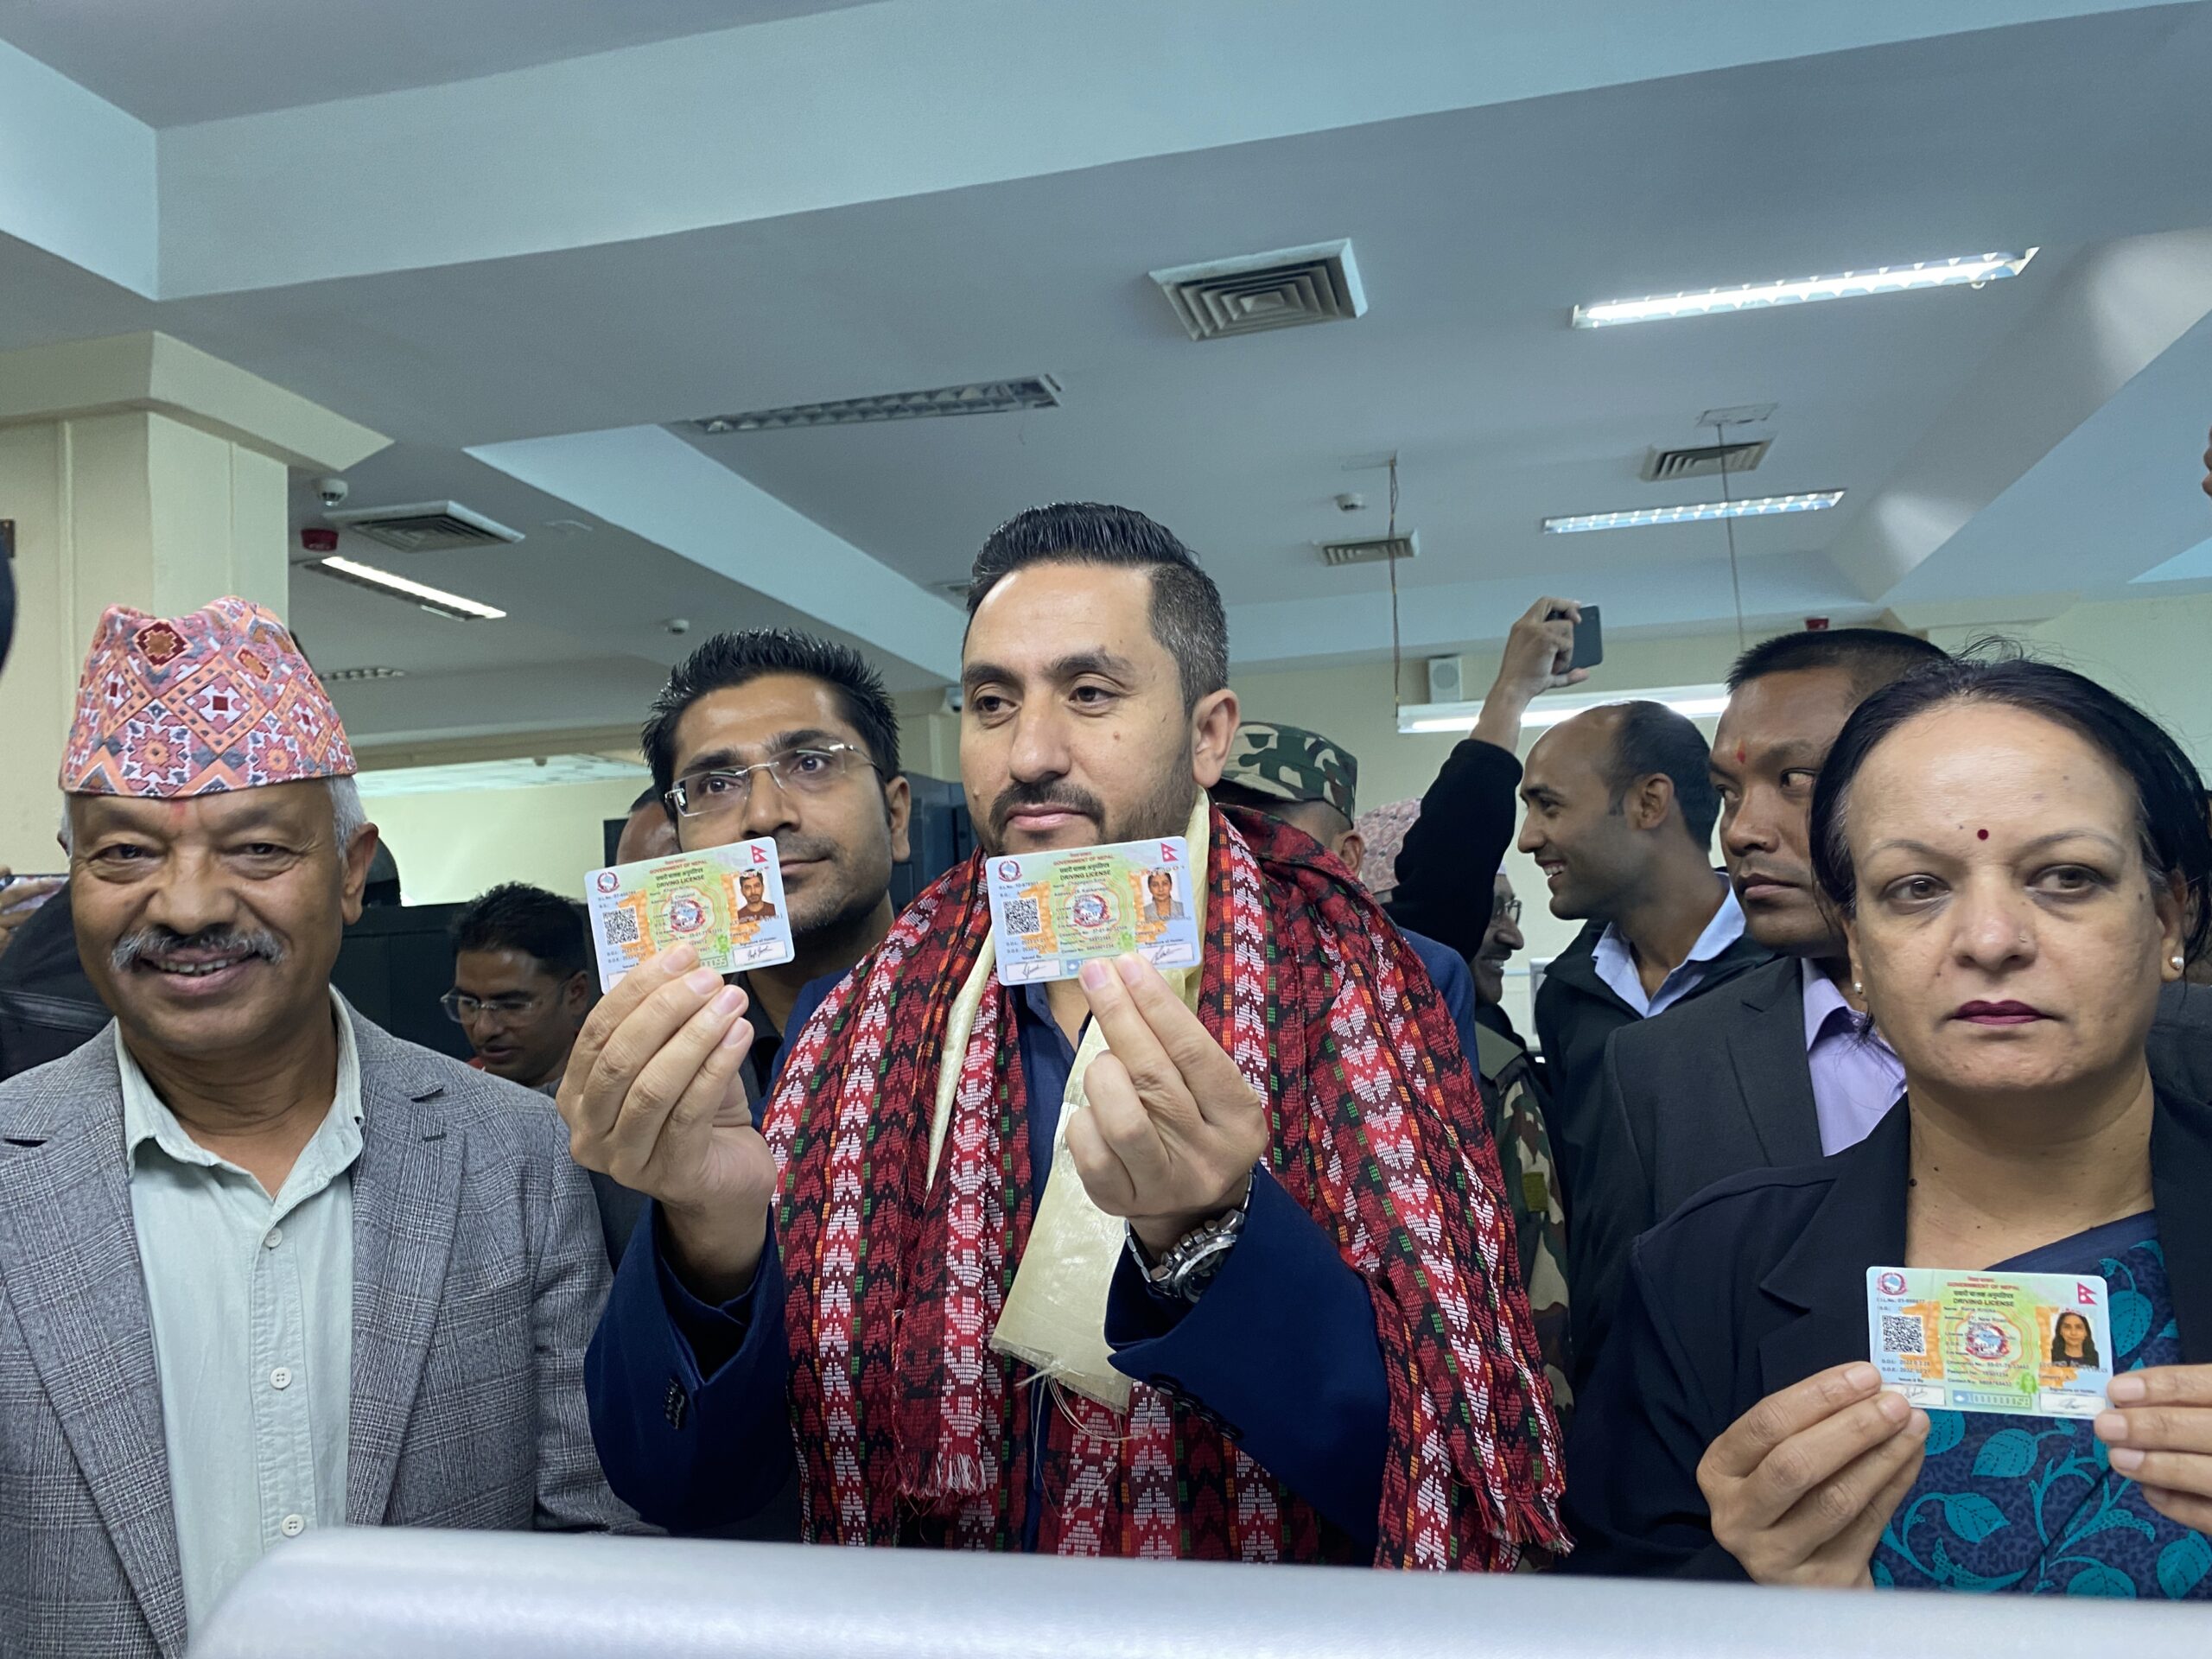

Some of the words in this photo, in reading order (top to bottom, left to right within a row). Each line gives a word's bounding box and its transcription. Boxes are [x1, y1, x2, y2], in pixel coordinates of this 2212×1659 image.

[1060, 872, 1084, 880] DRIVING
[1086, 869, 1111, 878] LICENSE
[657, 880, 680, 888] DRIVING
[681, 874, 704, 883] LICENSE
